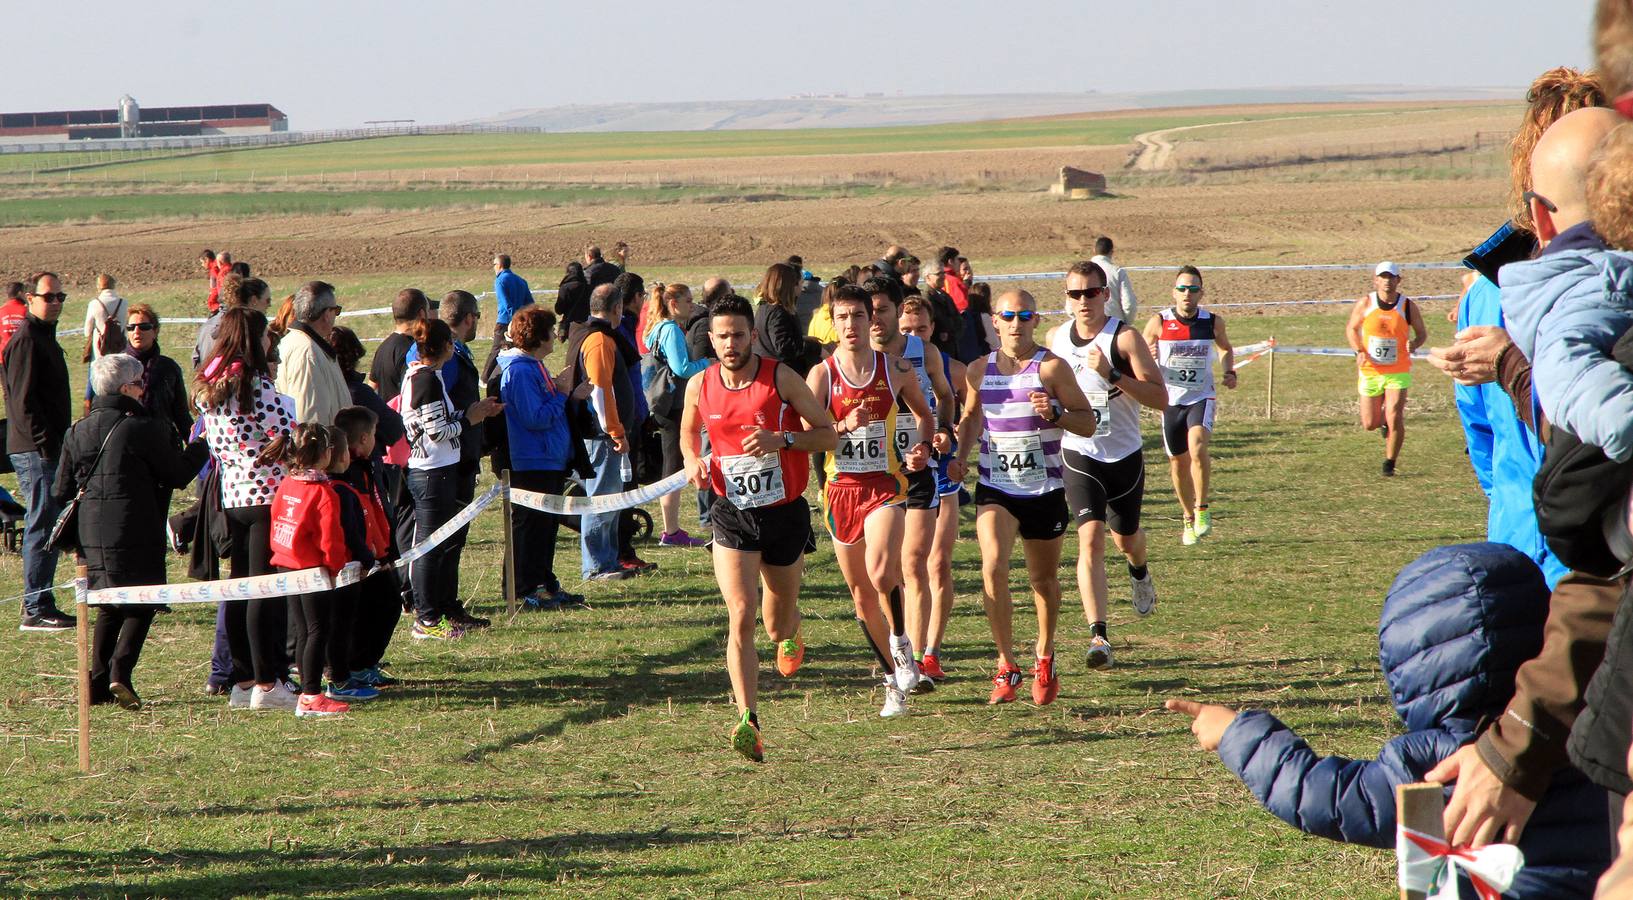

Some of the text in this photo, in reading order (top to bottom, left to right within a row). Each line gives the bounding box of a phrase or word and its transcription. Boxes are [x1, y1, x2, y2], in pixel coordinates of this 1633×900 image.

[1375, 347, 1390, 358] 97
[1178, 369, 1197, 382] 32
[841, 439, 880, 459] 416
[997, 453, 1038, 472] 344
[733, 470, 774, 496] 307
